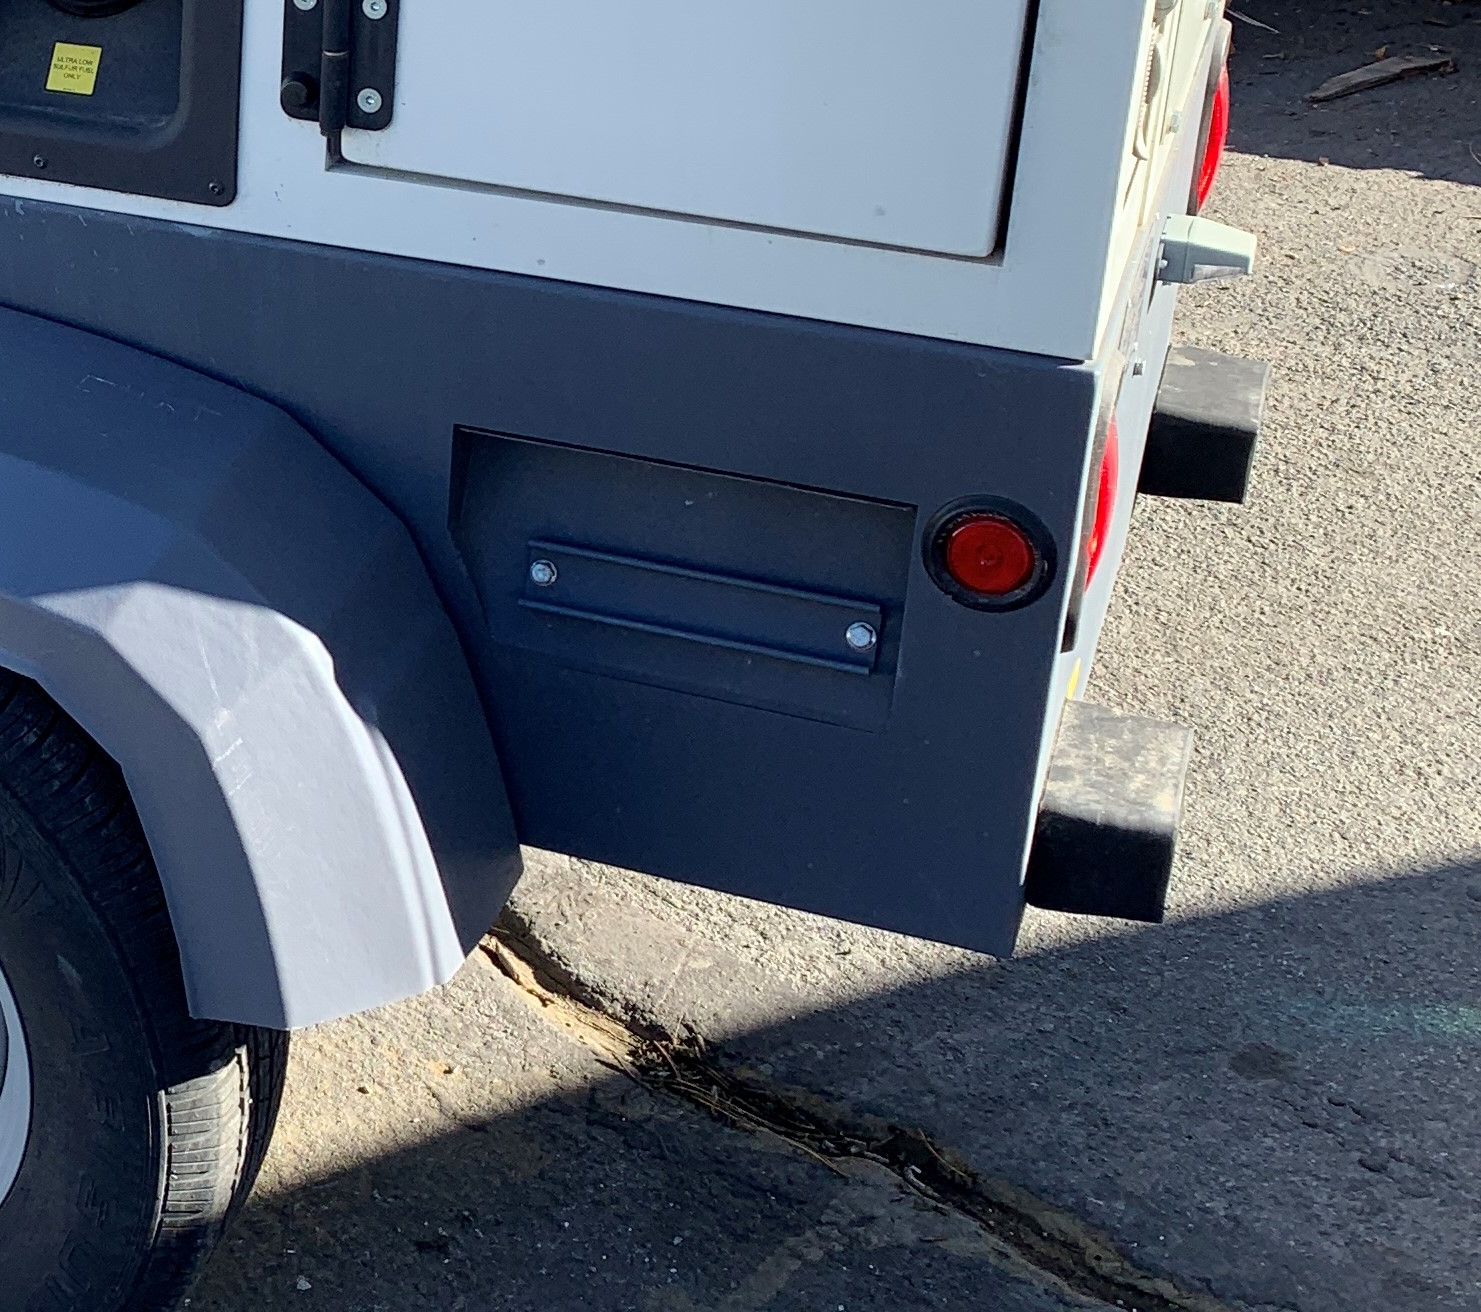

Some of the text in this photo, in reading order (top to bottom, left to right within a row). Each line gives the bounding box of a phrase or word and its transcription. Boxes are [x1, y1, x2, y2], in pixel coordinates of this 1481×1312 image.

[57, 56, 94, 66] ULTRA LOW
[53, 63, 95, 74] SULFUR FUEL
[63, 72, 81, 80] ONLY
